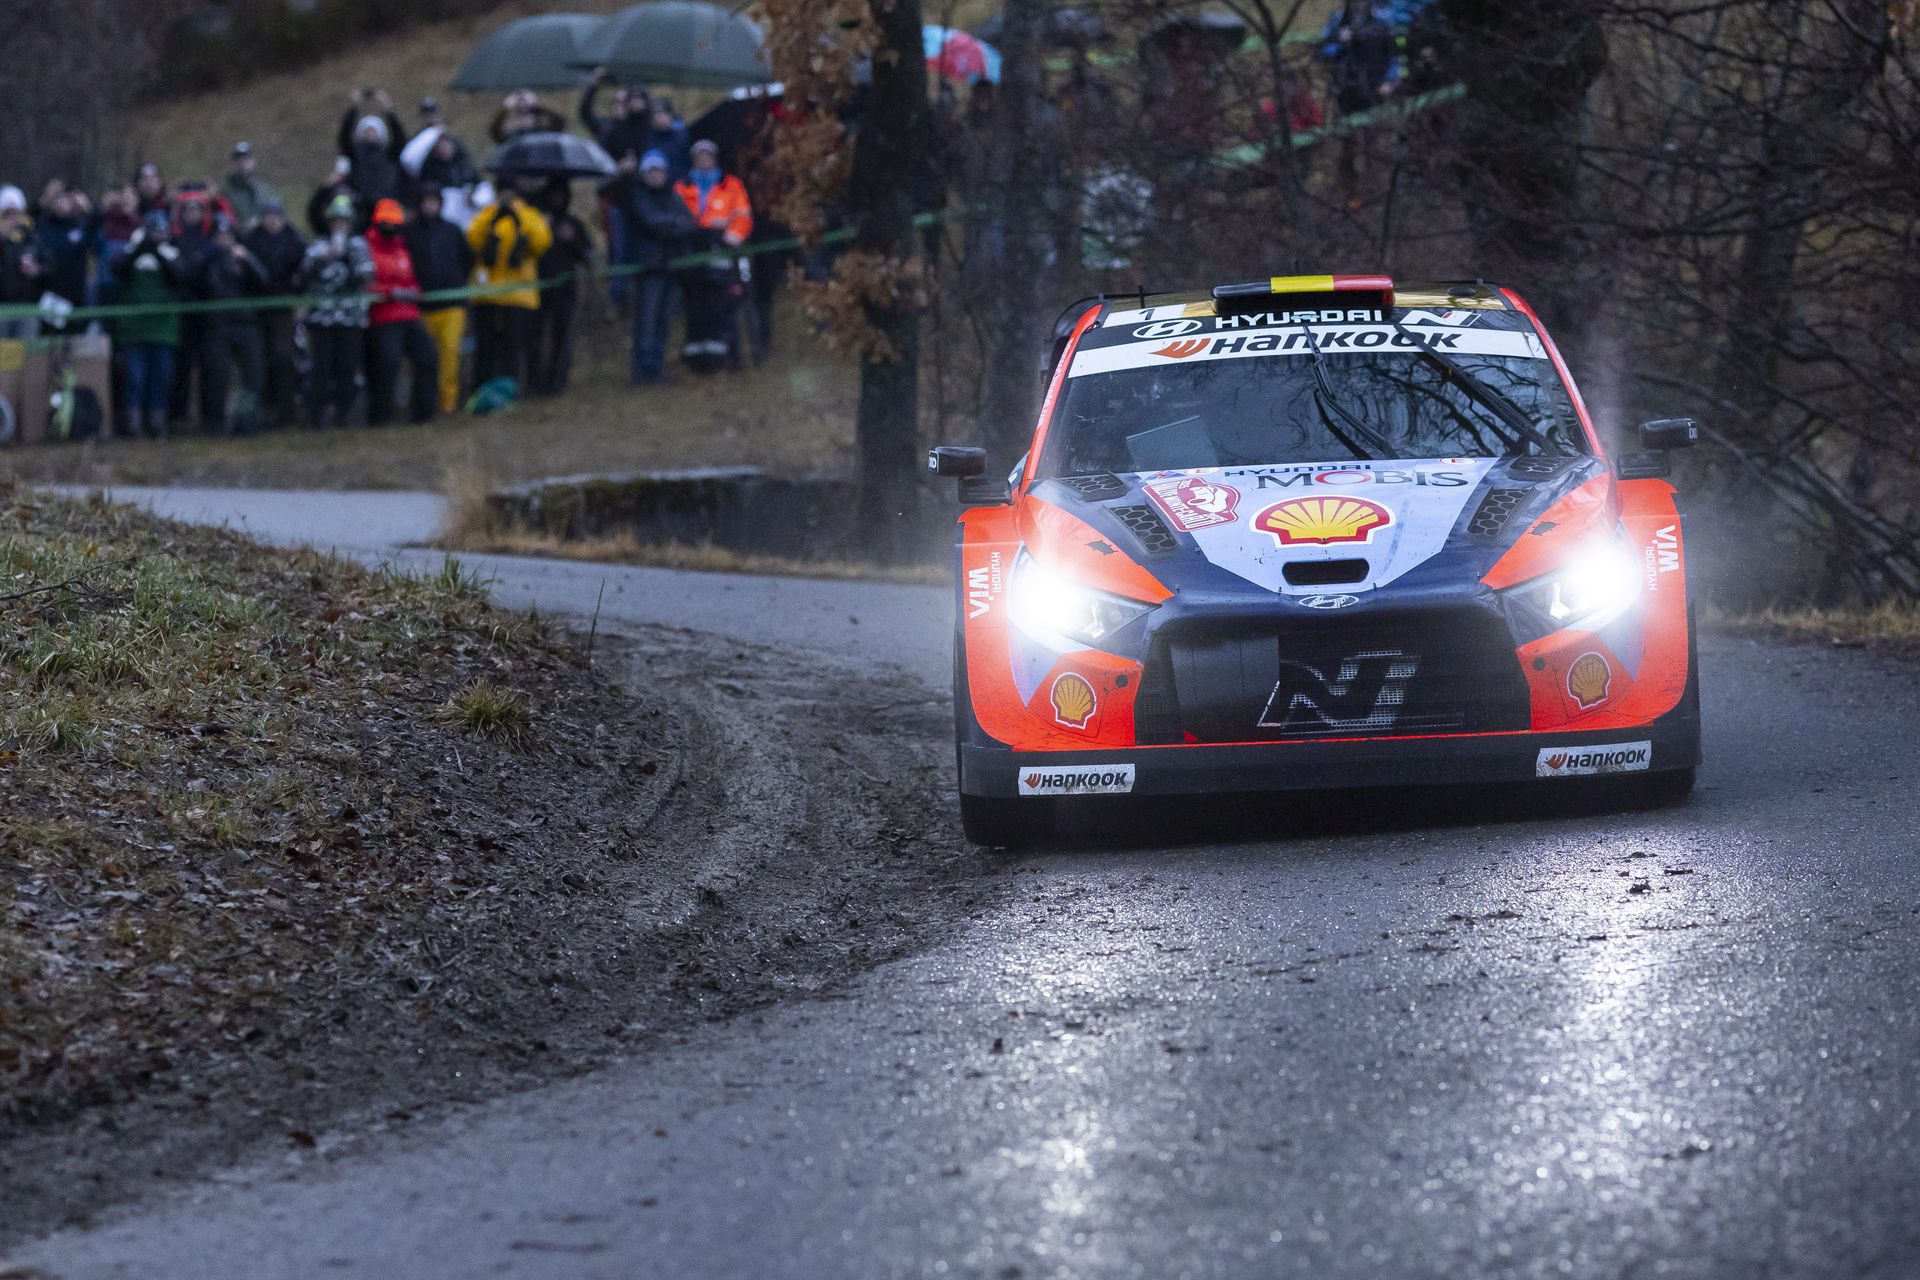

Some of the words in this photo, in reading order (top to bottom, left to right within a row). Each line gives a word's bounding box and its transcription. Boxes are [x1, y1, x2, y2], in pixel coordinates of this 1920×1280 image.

[1138, 308, 1156, 321] 1
[1215, 309, 1383, 329] HYUNDAI
[1224, 464, 1372, 477] HYUNDAI
[1256, 470, 1469, 489] MOBIS
[991, 551, 1002, 593] HYUNDAI
[1645, 546, 1658, 591] HYUNDAI
